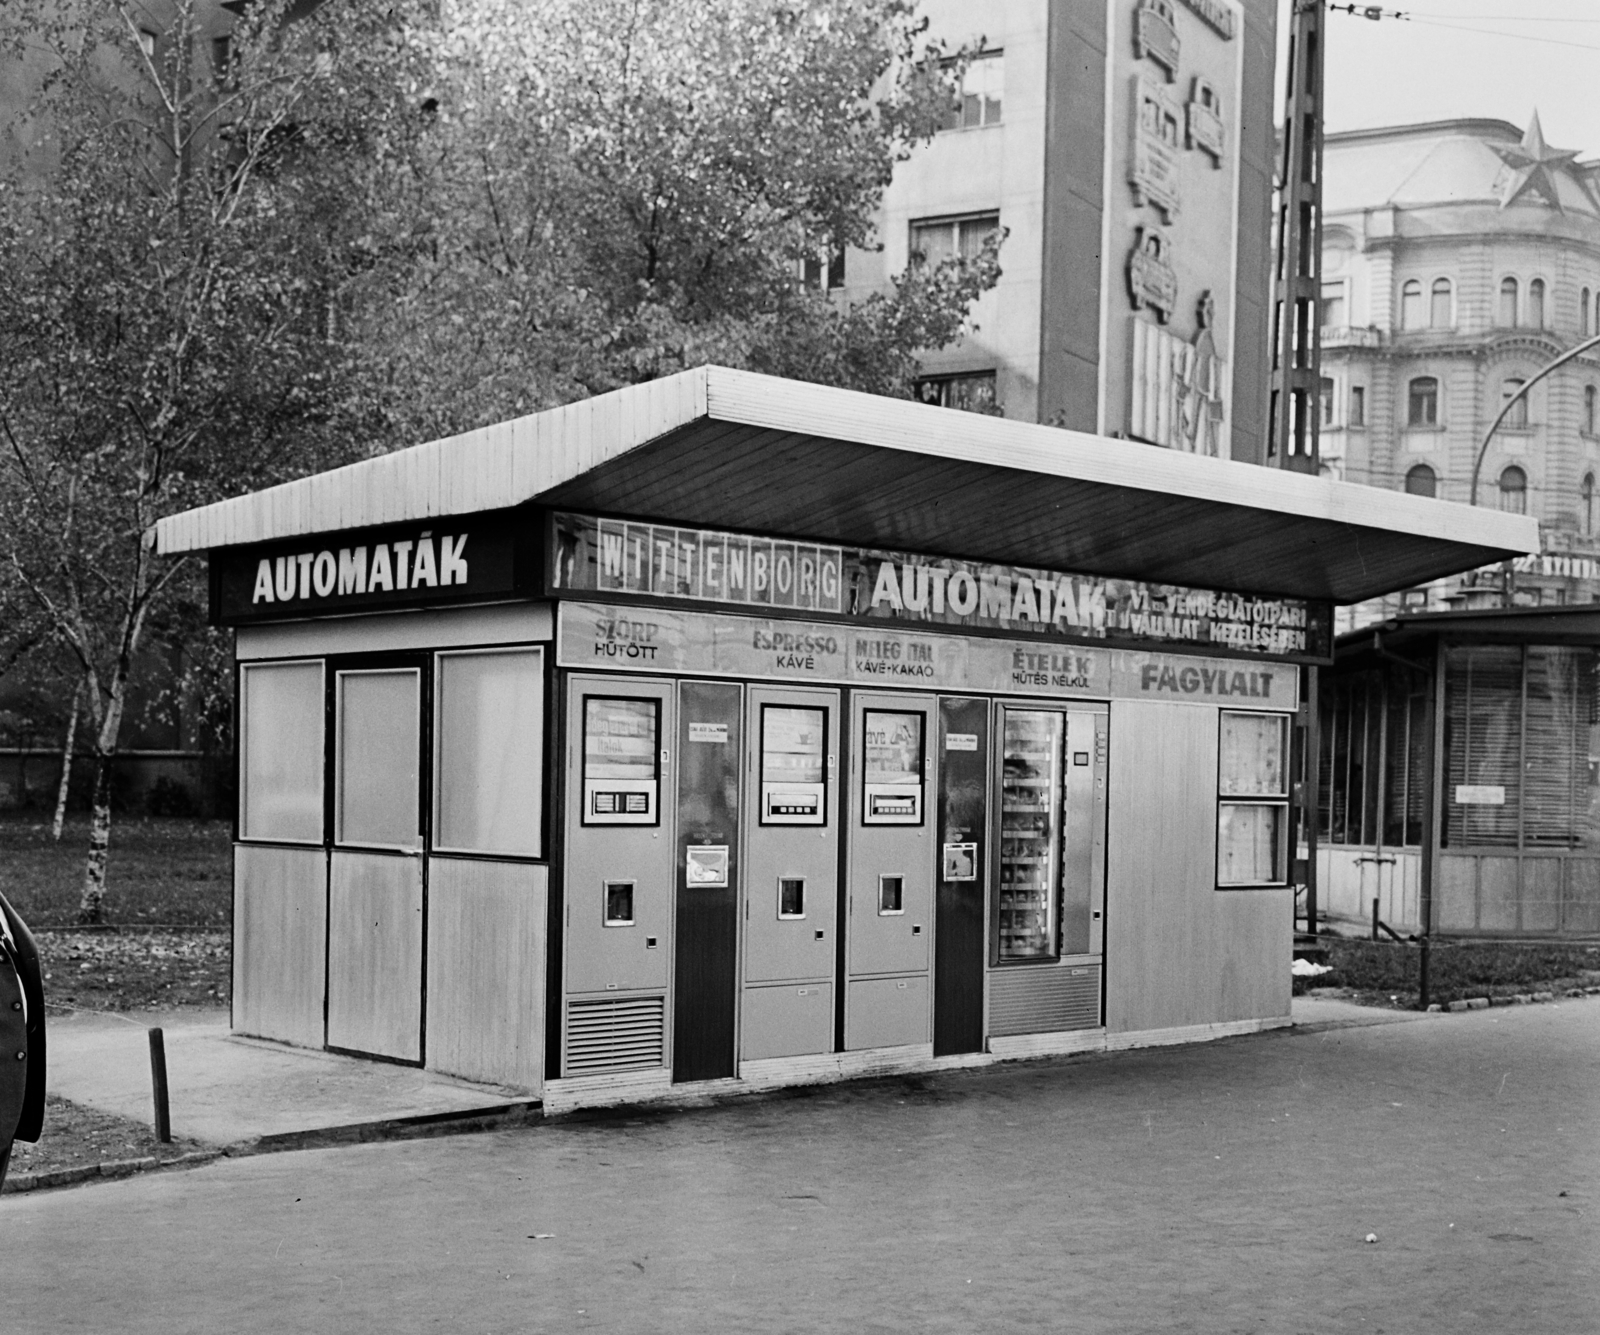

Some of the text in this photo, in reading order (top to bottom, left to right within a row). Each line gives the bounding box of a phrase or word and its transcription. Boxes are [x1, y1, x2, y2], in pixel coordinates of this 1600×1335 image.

[252, 530, 469, 605] AUTOMATÁK
[603, 533, 837, 599] WITTENBORG
[753, 630, 838, 655] ESPRESSO
[856, 640, 901, 660] MELEG
[776, 653, 815, 670] KÁVÉ
[1012, 648, 1091, 675] ÉTELEK
[1141, 664, 1274, 699] FAGYLALT
